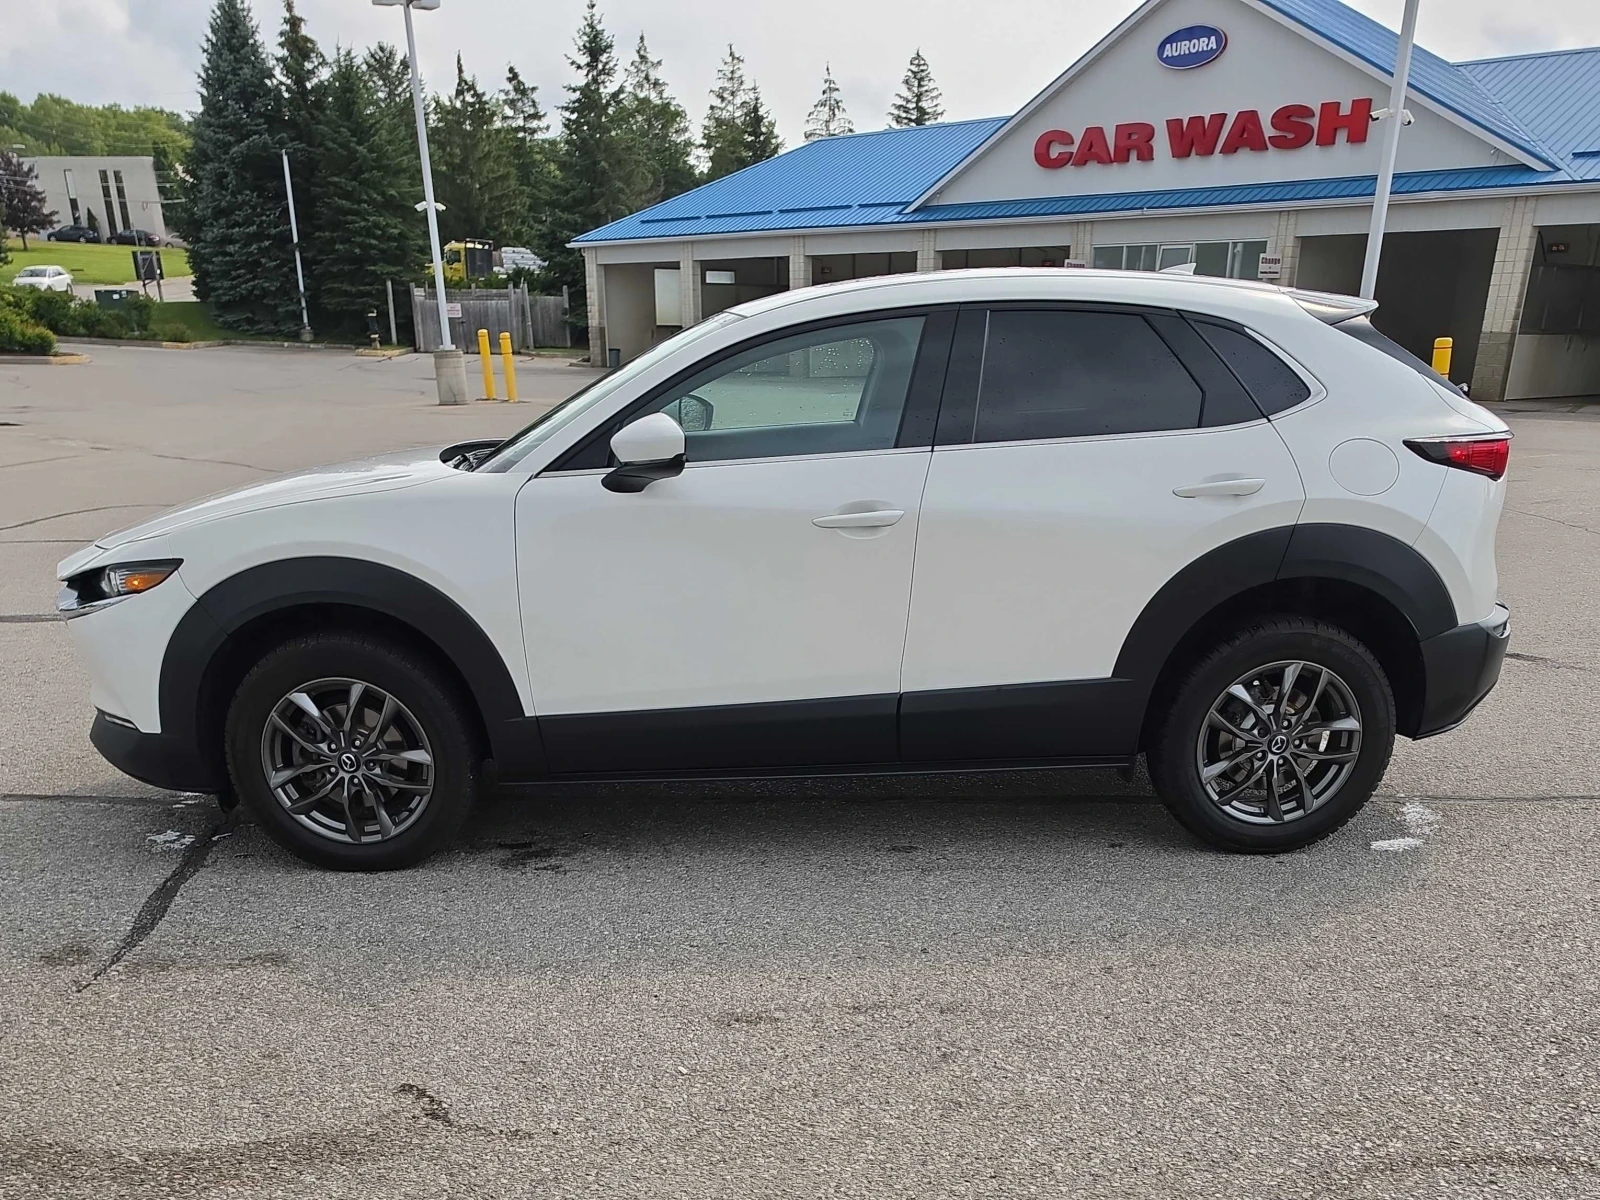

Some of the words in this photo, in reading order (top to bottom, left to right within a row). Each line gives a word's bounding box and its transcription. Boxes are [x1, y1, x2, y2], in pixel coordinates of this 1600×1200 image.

[1163, 35, 1217, 58] AURORA
[1034, 122, 1154, 169] CAR
[1166, 98, 1373, 158] WASH
[1261, 256, 1281, 265] Change
